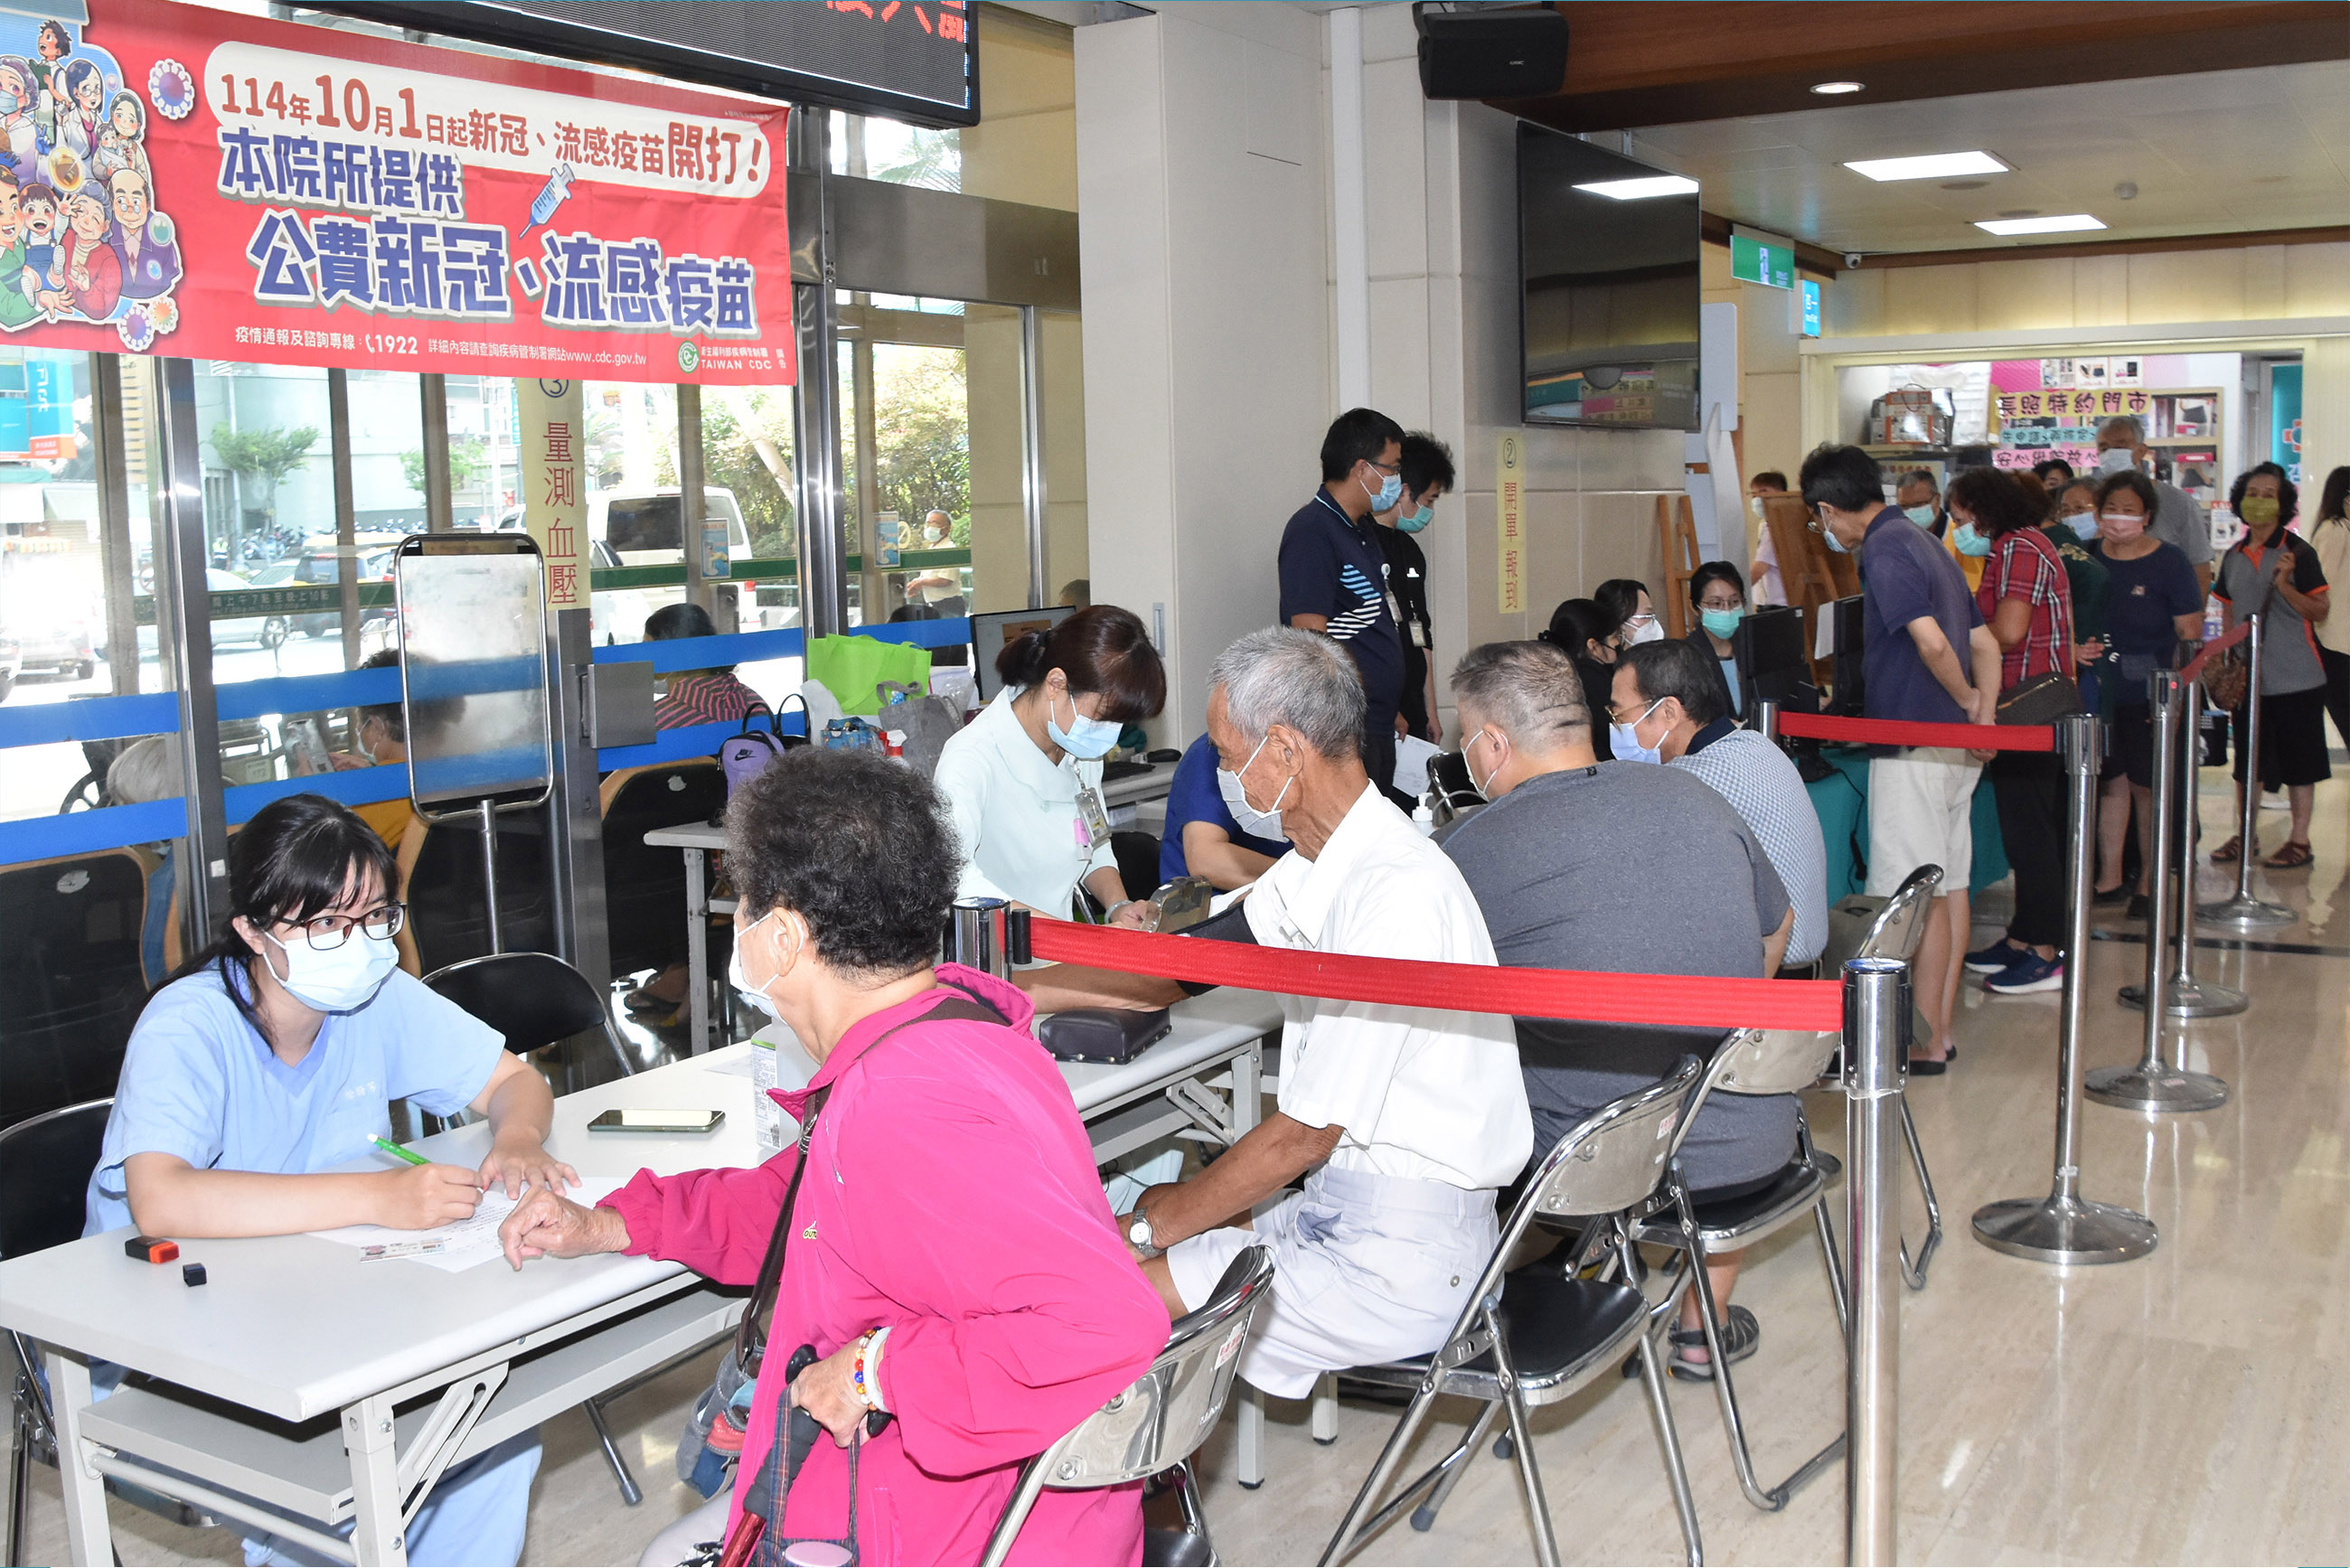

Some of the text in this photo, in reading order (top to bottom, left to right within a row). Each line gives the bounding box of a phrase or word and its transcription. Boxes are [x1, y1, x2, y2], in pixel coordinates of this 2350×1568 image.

[220, 125, 461, 215] 本院所提供
[249, 213, 754, 330] 公費新冠、流感疫苗
[375, 334, 418, 355] 1922
[701, 360, 772, 370] TAIWAN CDC
[1997, 391, 2148, 416] 長照特約門市
[542, 422, 577, 605] 量測血壓
[1504, 482, 1518, 609] 開單報到
